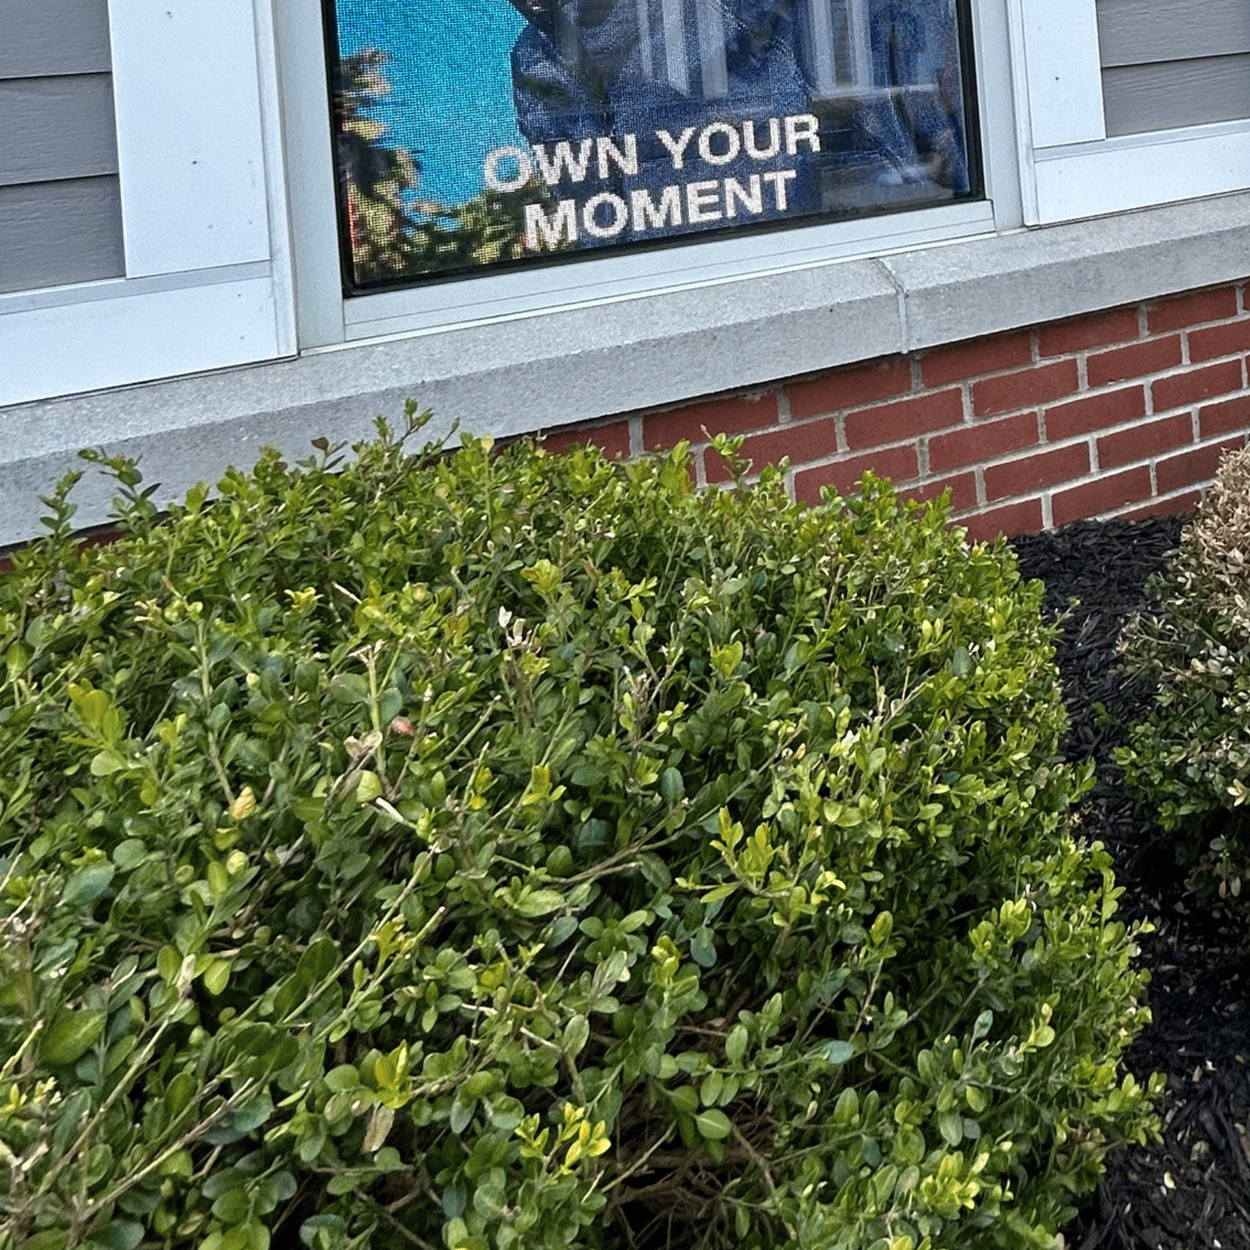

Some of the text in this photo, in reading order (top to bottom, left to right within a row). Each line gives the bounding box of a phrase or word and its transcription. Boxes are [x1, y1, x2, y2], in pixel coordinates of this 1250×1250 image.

[483, 112, 822, 193] OWN YOUR
[524, 169, 797, 250] MOMENT
